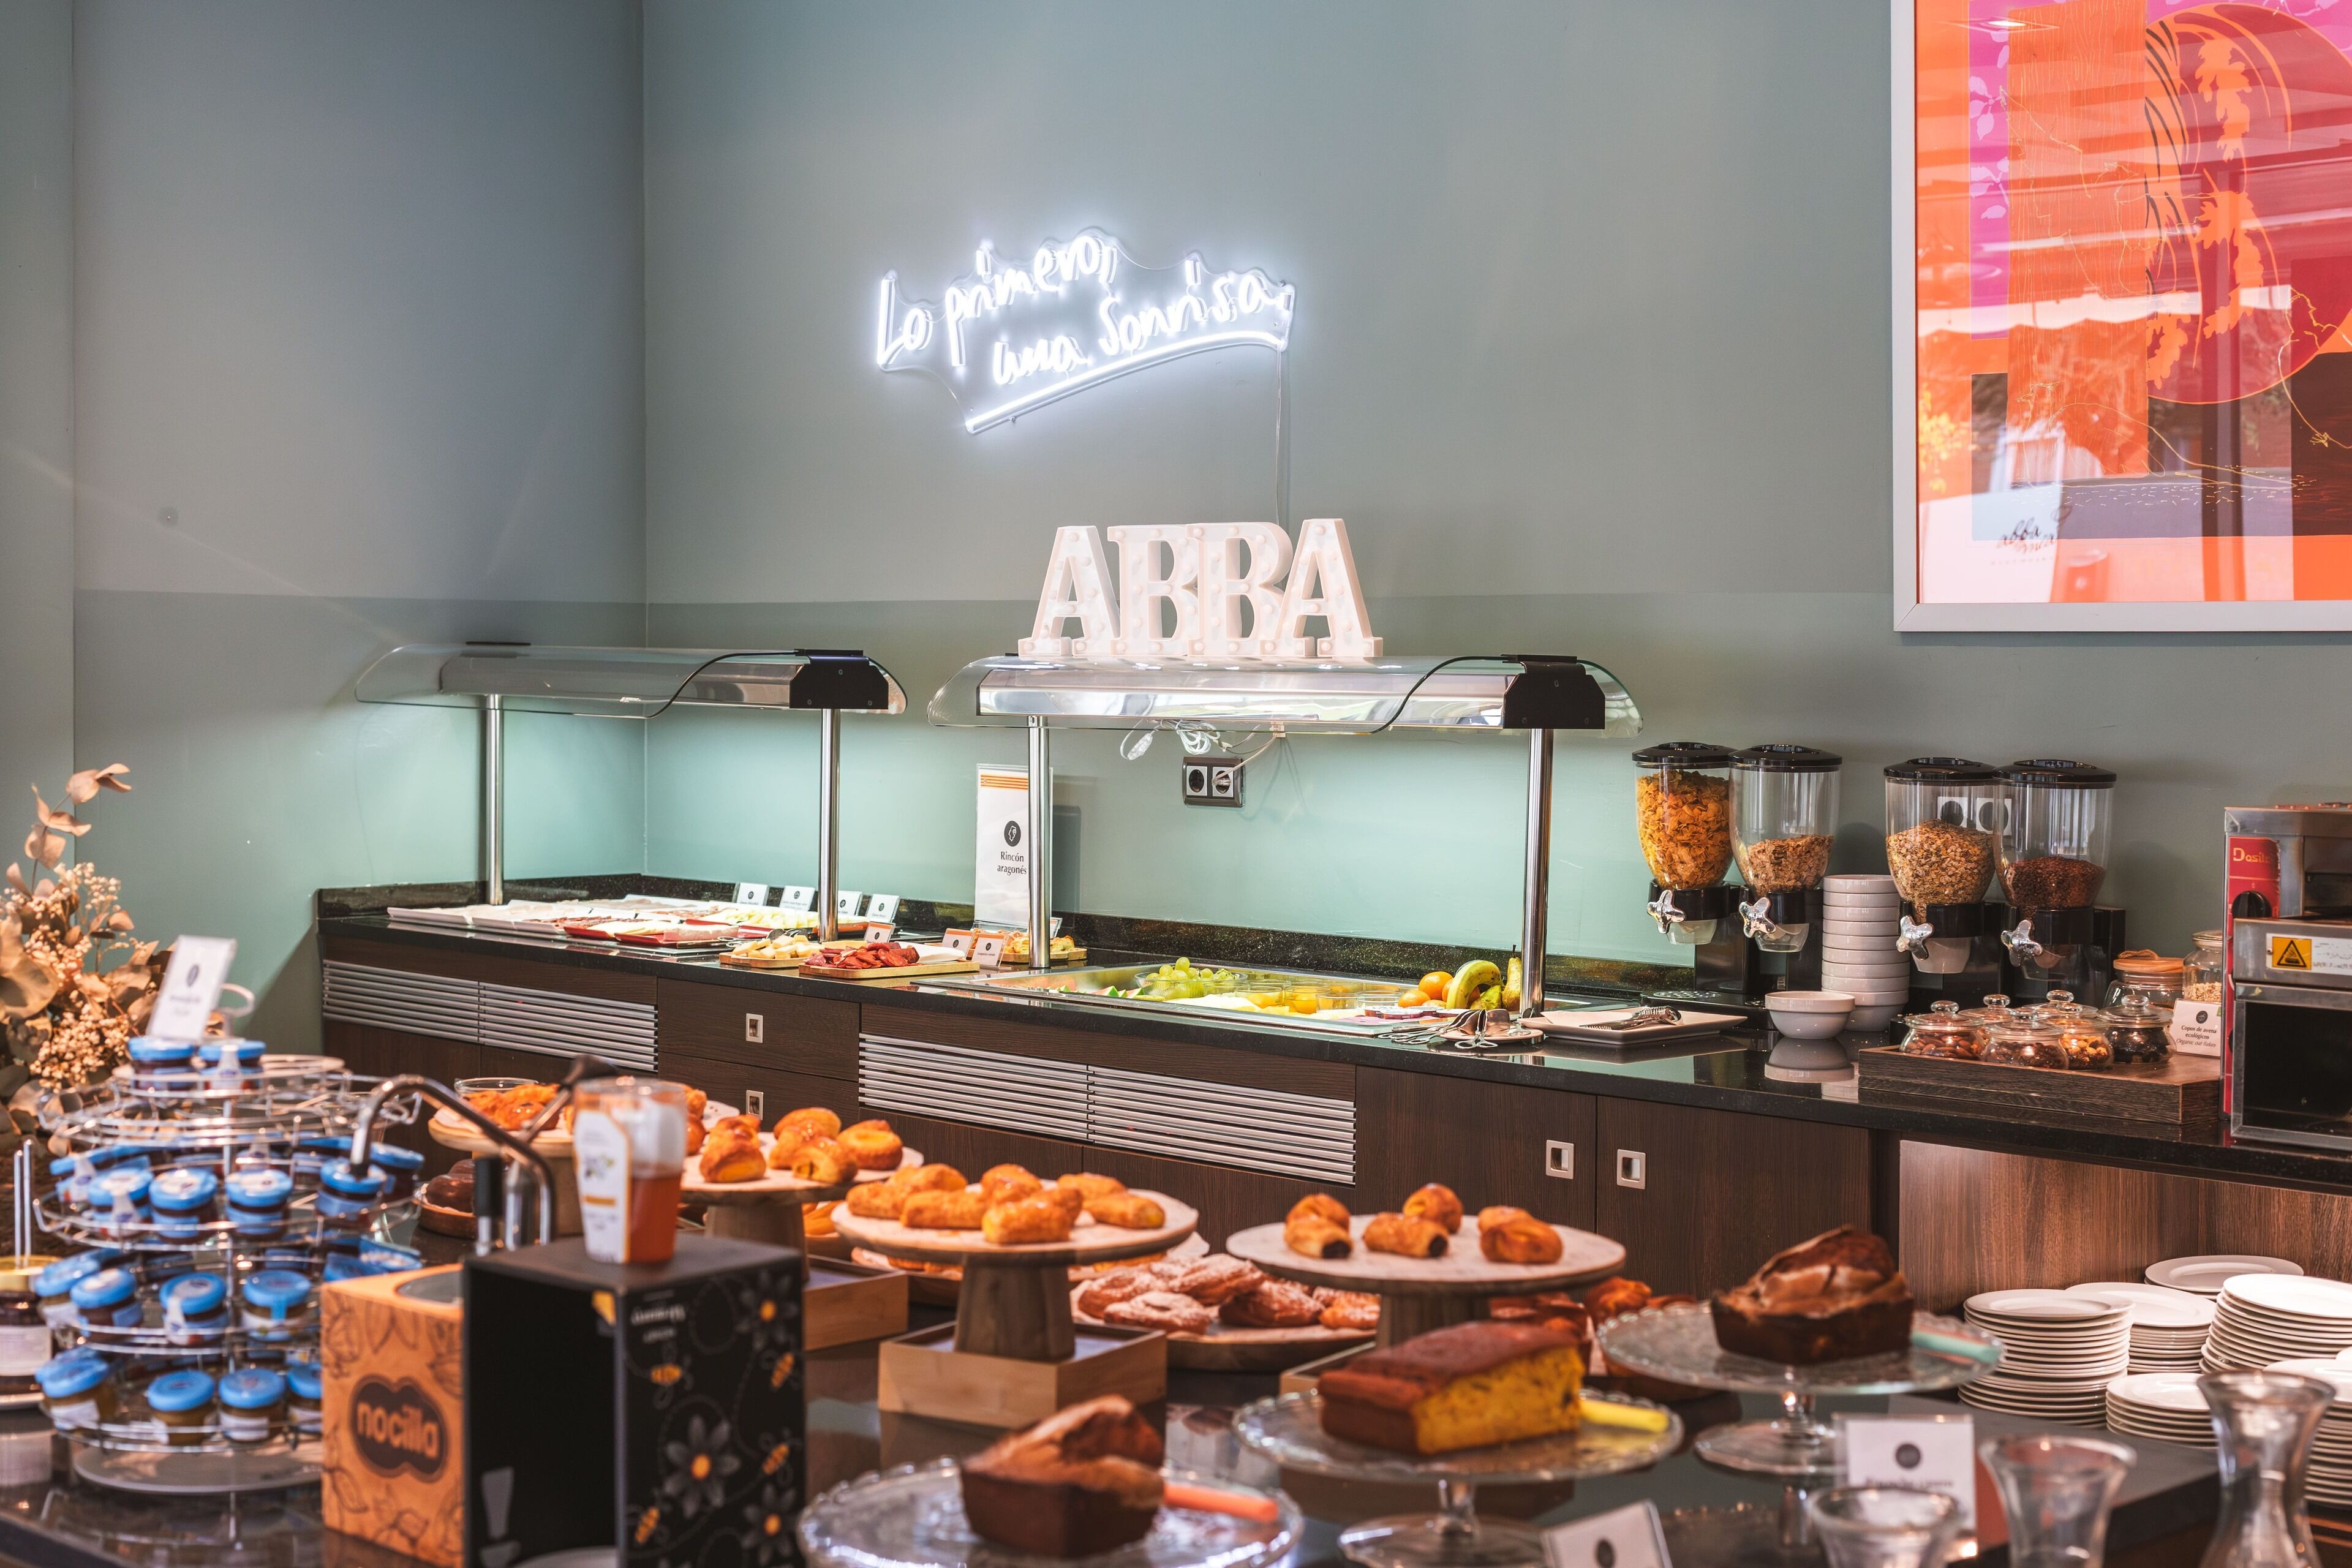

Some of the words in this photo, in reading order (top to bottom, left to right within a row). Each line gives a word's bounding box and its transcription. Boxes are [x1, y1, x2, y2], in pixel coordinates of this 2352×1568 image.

[876, 278, 933, 366] Lo
[993, 340, 1095, 385] una
[1018, 518, 1383, 657] ABBA
[997, 864, 1027, 876] aragonés
[1000, 851, 1024, 862] Rincón
[357, 1401, 439, 1459] nocilla
